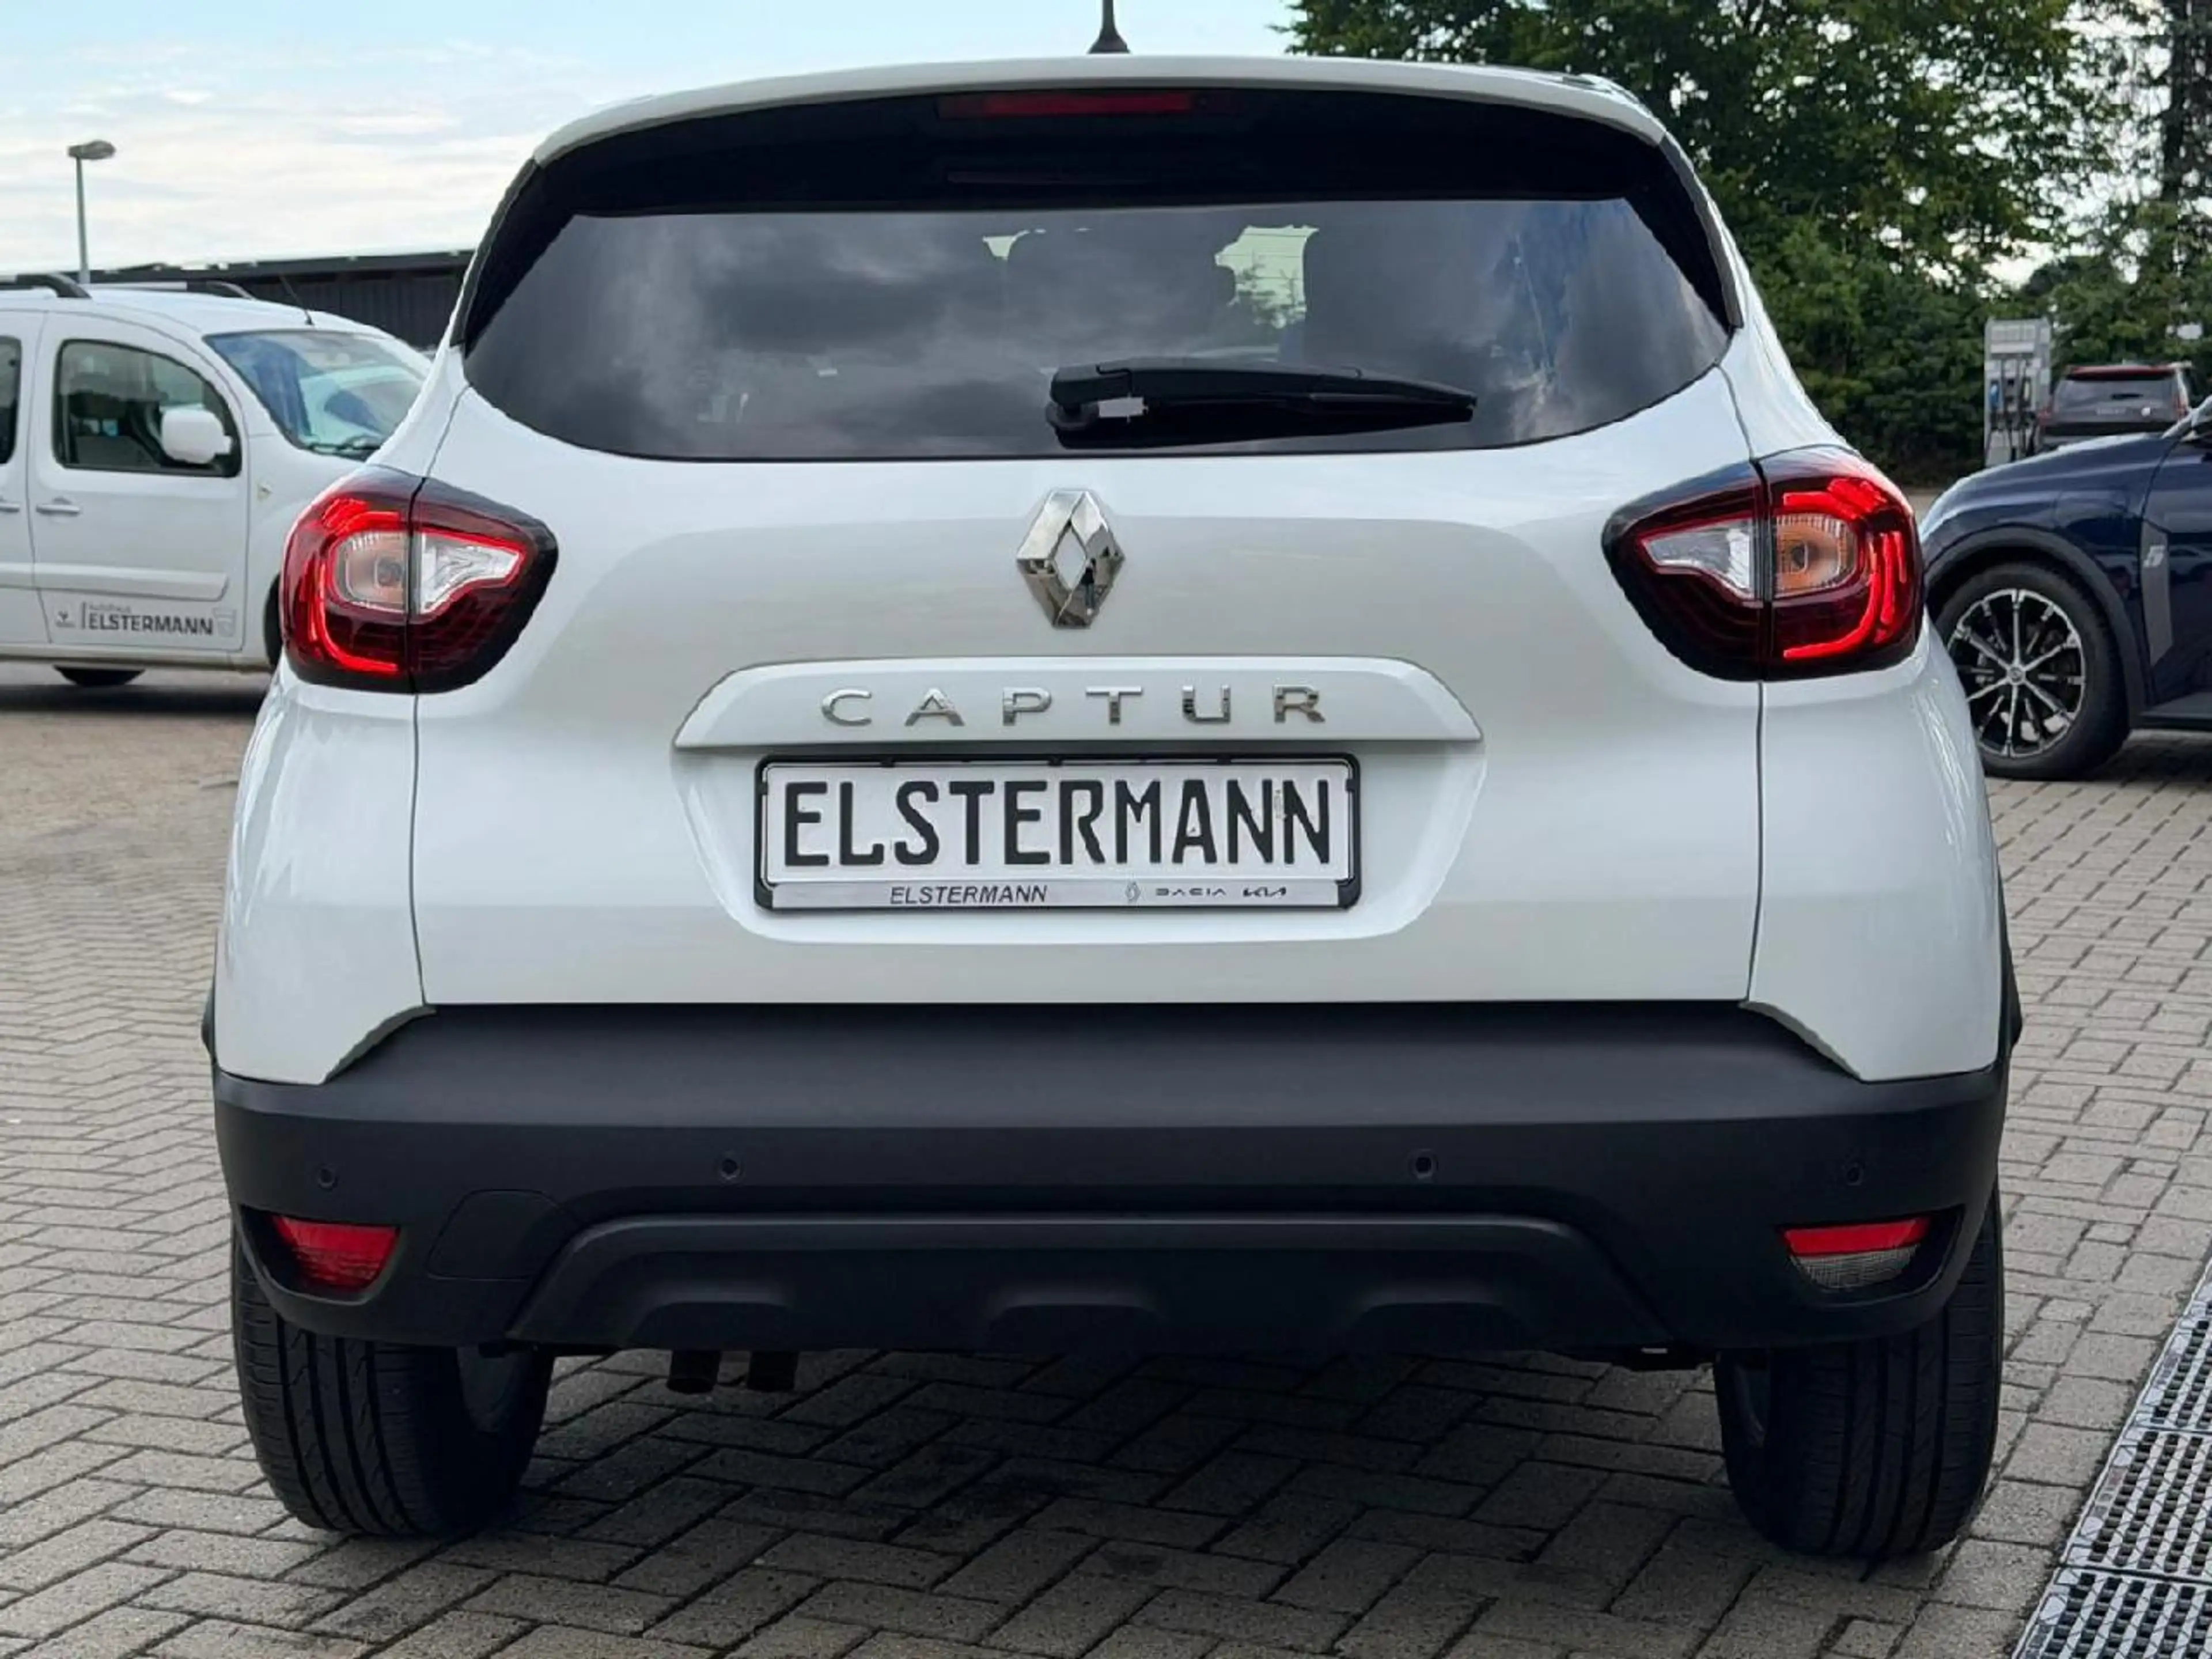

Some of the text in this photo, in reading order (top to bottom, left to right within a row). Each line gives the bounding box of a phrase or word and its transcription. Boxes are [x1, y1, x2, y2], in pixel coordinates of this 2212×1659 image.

[89, 613, 213, 635] ELSTERMANN
[821, 685, 1325, 726] CAPTUR
[785, 779, 1329, 866] ELSTERMANN
[890, 885, 1048, 906] ELSTERMANN
